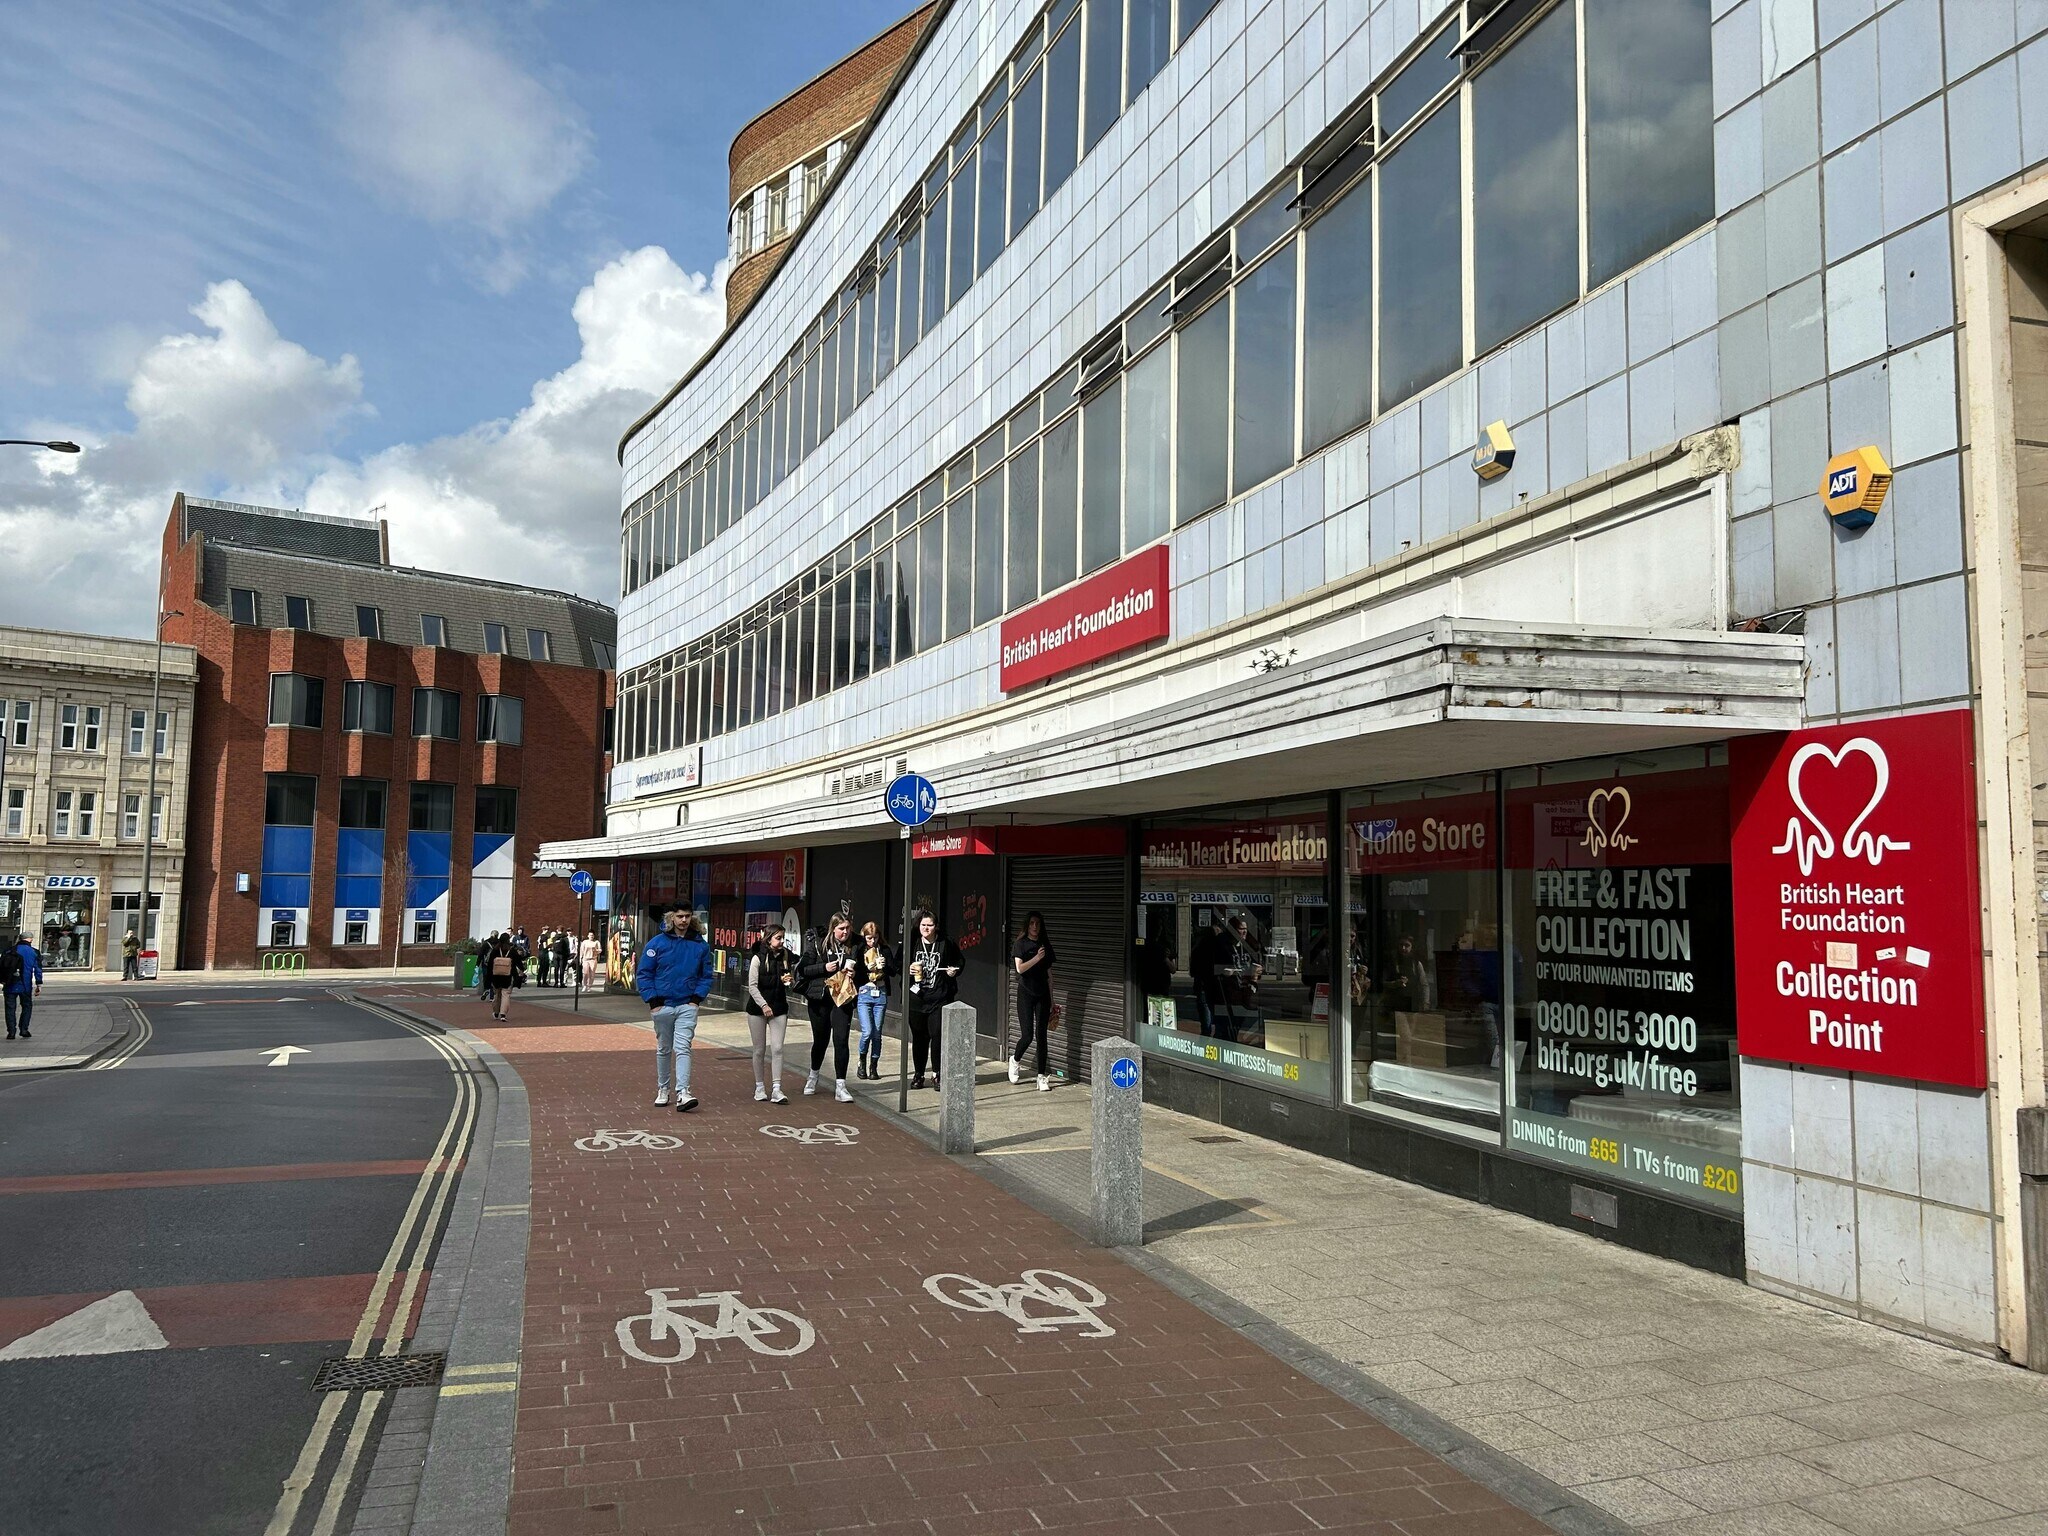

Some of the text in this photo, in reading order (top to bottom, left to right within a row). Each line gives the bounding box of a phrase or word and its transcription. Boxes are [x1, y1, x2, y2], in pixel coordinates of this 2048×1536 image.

[1829, 470, 1856, 495] ADT
[1003, 588, 1154, 668] British Heart Foundation
[930, 834, 962, 852] Home Store
[1150, 831, 1328, 868] British Heart Foundation
[1360, 818, 1485, 855] Home Store
[47, 876, 96, 887] BEDS
[532, 861, 576, 869] HALIFAX
[1535, 868, 1691, 910] FREE & FAST
[1780, 883, 1905, 906] British Heart
[714, 927, 737, 948] FOOD
[1535, 915, 1691, 961] COLLECTION
[1781, 907, 1905, 934] Foundation
[1536, 961, 1693, 993] OF YOUR UNWANTED ITEMS
[1776, 960, 1918, 1006] Collection
[1537, 1000, 1697, 1054] 0800 915 3000
[1809, 1008, 1884, 1054] Point
[1157, 1034, 1299, 1081] WARDROBES from £50 MATTRESSES from £45
[1536, 1037, 1698, 1097] bhf.org.uk/free
[1512, 1118, 1738, 1195] DINING from £65 TVs from £20
